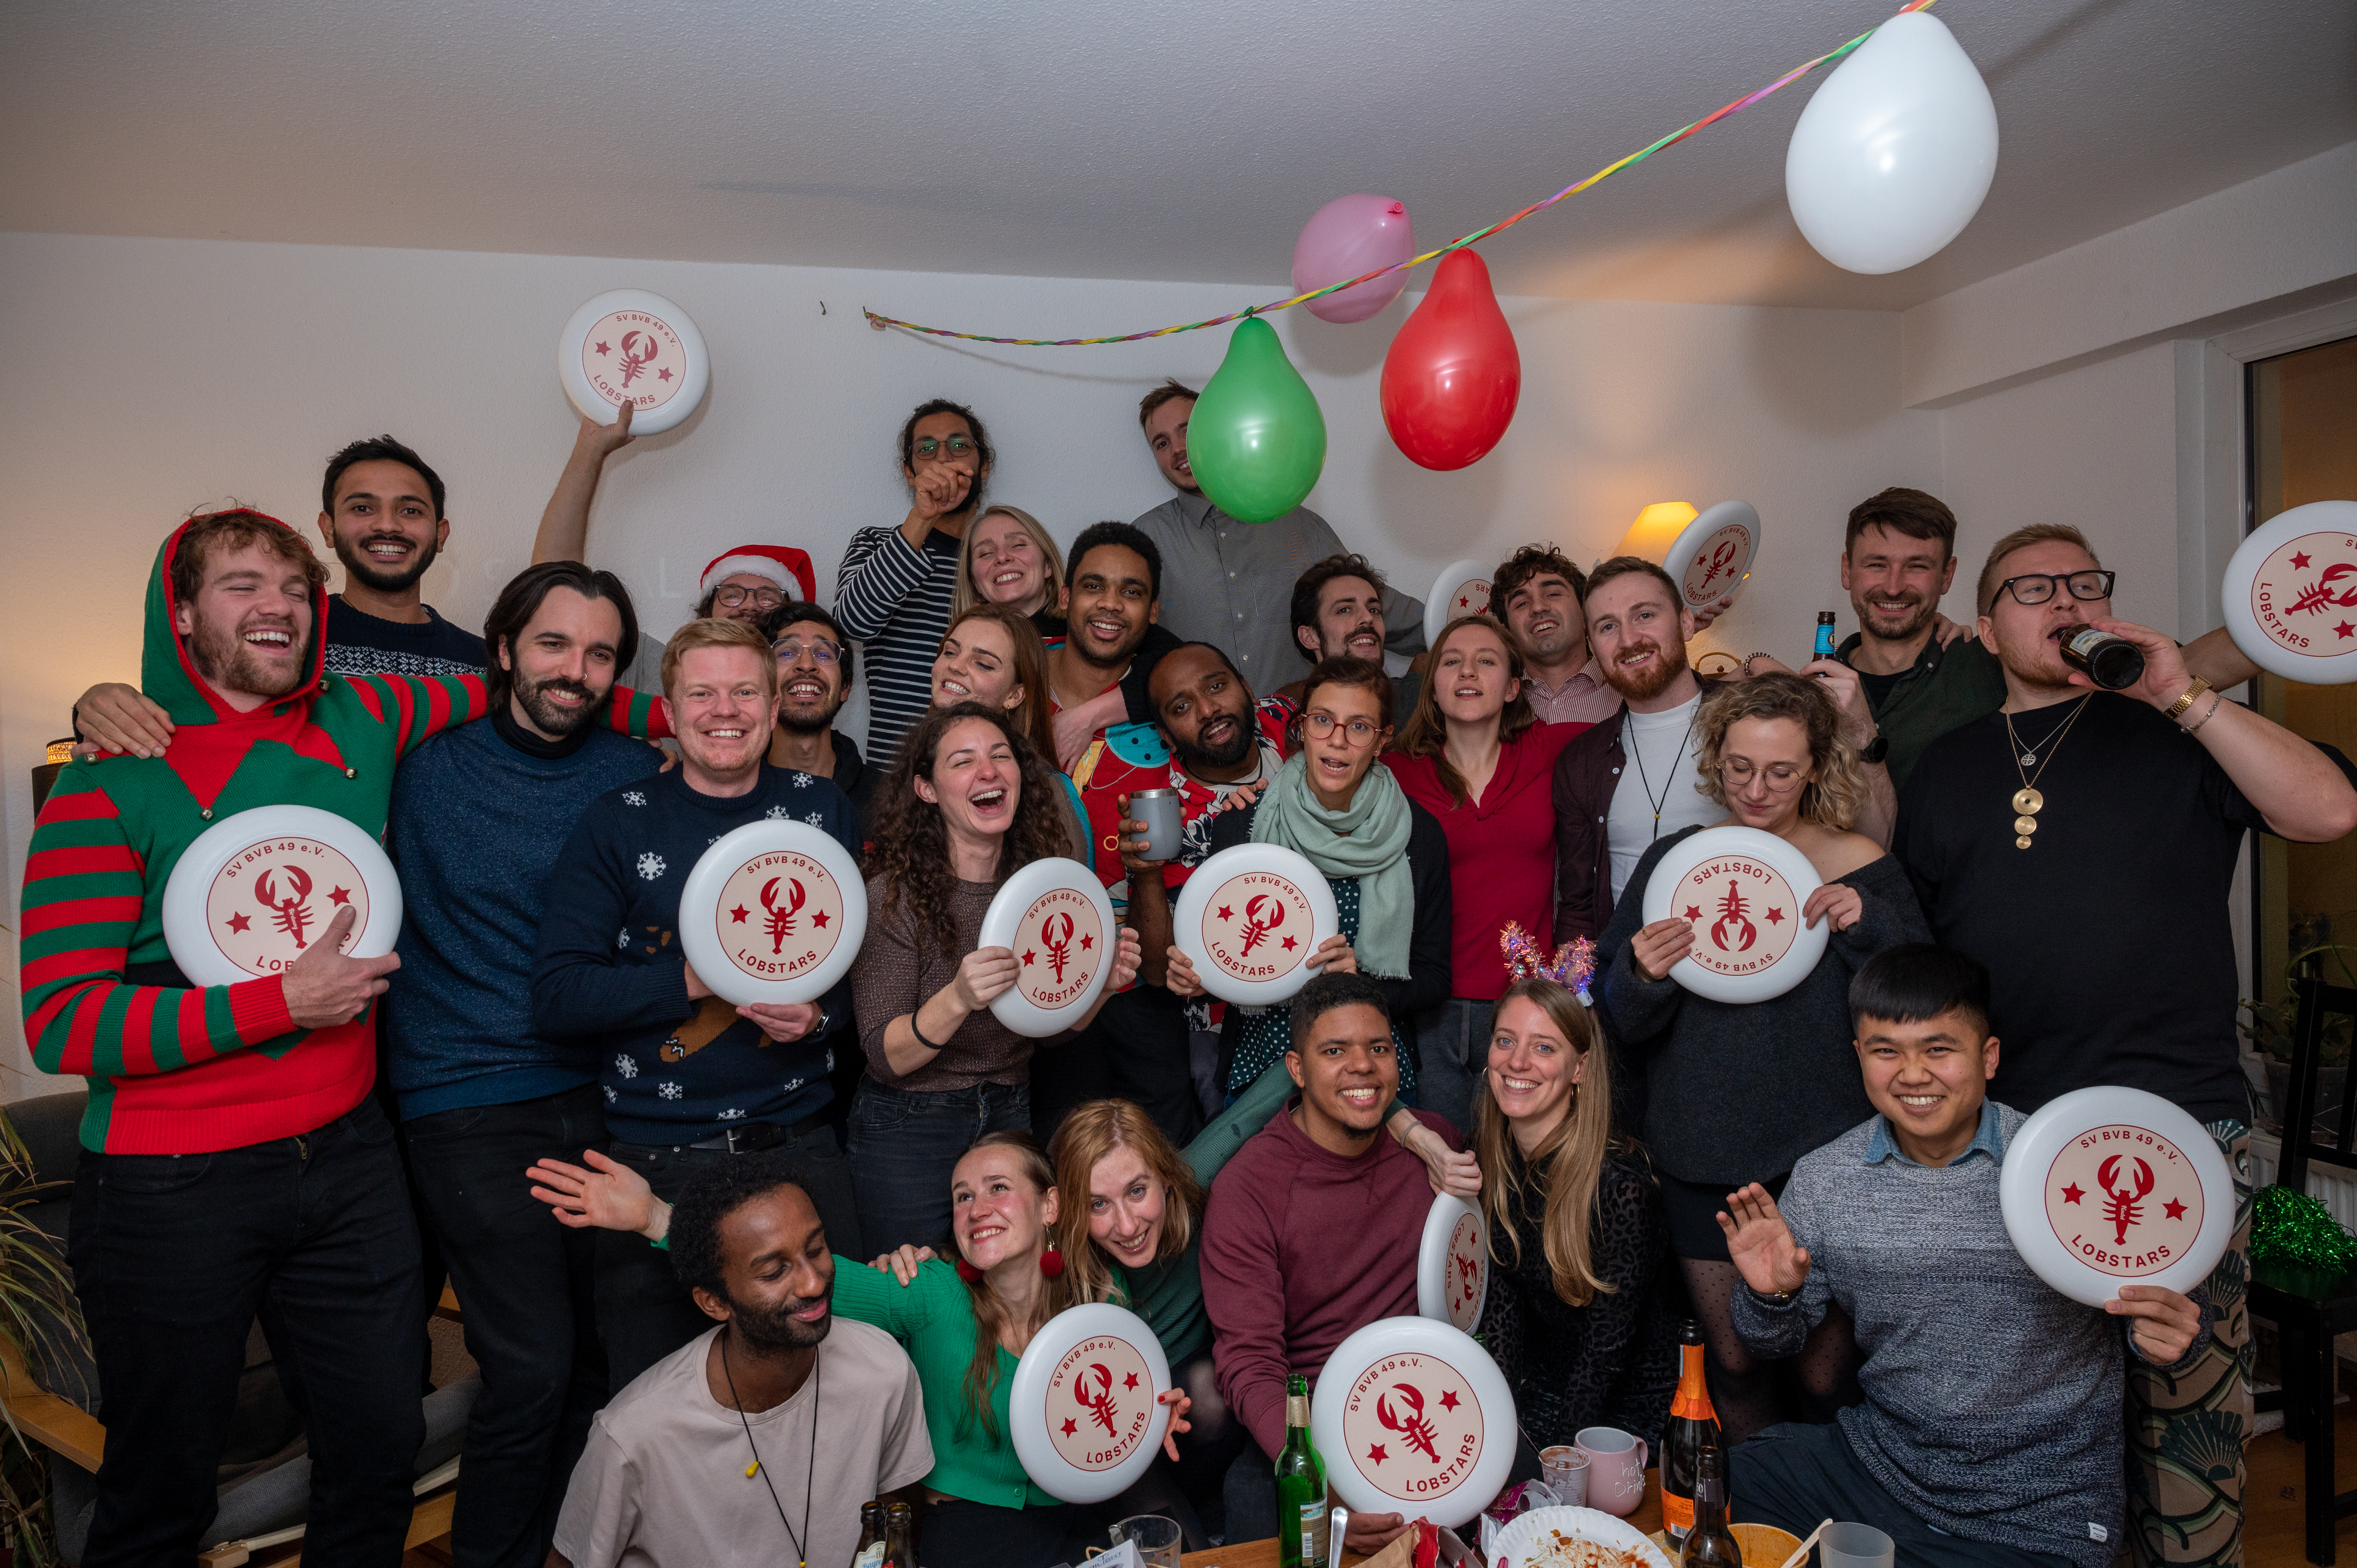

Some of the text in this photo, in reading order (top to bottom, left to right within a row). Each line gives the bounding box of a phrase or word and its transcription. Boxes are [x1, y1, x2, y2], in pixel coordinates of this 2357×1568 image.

[632, 314, 650, 323] BVB
[653, 322, 663, 330] 49
[664, 332, 676, 347] e.V.
[594, 374, 655, 405] LOBSTARS
[2345, 539, 2357, 549] S
[1686, 582, 1717, 601] LOBSTARS
[2259, 583, 2310, 648] LOBSTARS
[227, 842, 324, 878] SV BVB 49 e.V.
[747, 856, 825, 882] SV BVB 49 e.V.
[1693, 862, 1772, 885] LOBSTARS
[1029, 906, 1039, 919] SV
[1041, 894, 1057, 908] BVB
[1072, 897, 1085, 909] e.V.
[1244, 876, 1306, 913] SV BVB 49 e.V.
[288, 908, 298, 930] Birdsong
[1249, 926, 1259, 942] Johanna
[737, 948, 816, 973] LOBSTARS
[1211, 941, 1275, 976] LOBSTARS
[1695, 948, 1712, 963] e.V.
[1733, 961, 1756, 971] BVB
[1760, 953, 1773, 966] SV
[1032, 971, 1088, 1003] LOBSTARS
[2081, 1130, 2178, 1165] SV BVB 49 e.V.
[1447, 1222, 1465, 1289] LOBSTARS
[2071, 1234, 2170, 1268] LOBSTARS
[1474, 1299, 1479, 1310] 49
[1053, 1341, 1115, 1388] SV BVB 49 e.V.
[1350, 1358, 1422, 1412] SV BVB 49 e.V.
[1086, 1412, 1145, 1464] LOBSTARS
[1414, 1427, 1426, 1444] Nelson
[1406, 1434, 1475, 1492] LOBSTARS
[1621, 1458, 1640, 1477] hot
